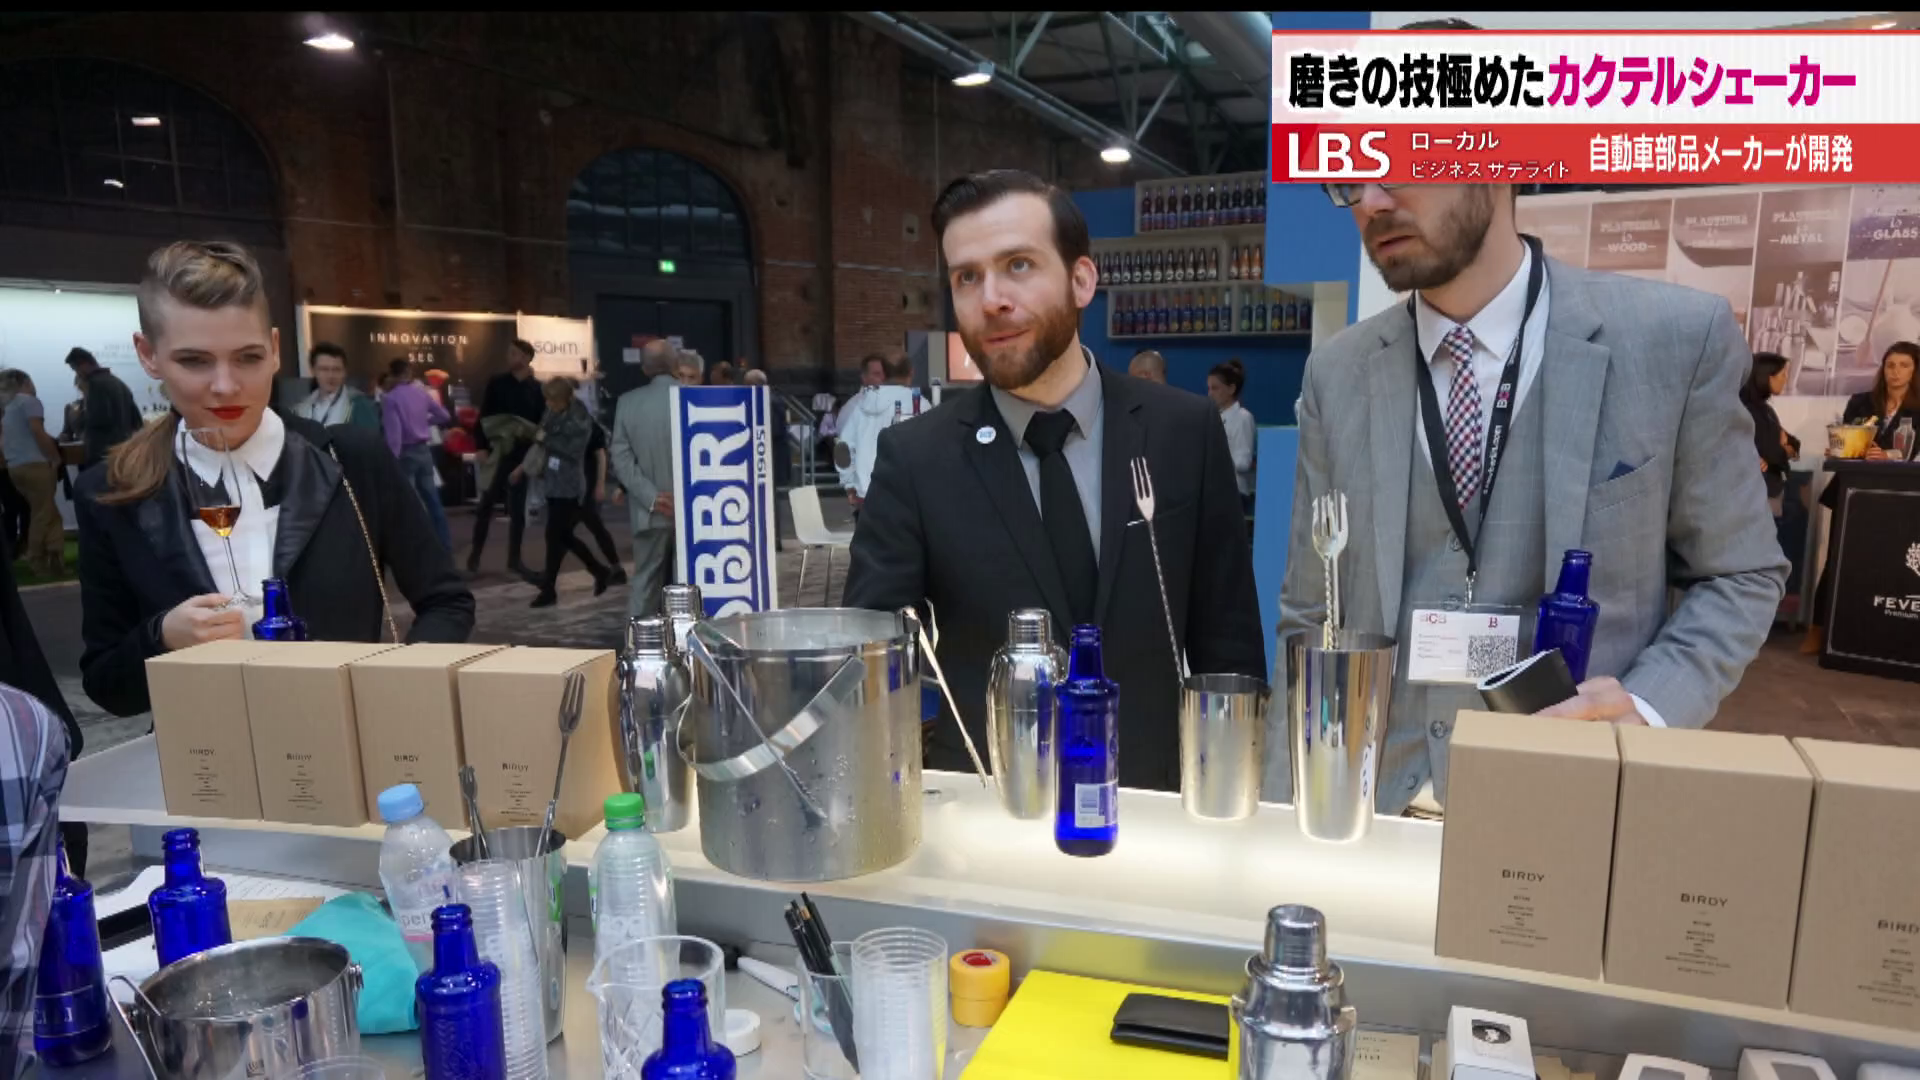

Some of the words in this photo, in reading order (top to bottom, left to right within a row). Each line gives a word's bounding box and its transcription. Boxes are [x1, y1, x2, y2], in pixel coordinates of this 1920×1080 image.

[1607, 241, 1648, 254] WOOD
[1780, 234, 1824, 246] METAL
[369, 331, 469, 346] INNOVATION
[756, 428, 767, 482] 1905
[687, 400, 754, 618] BBRI
[1502, 868, 1545, 882] BIRDY
[1681, 893, 1729, 908] BIRDY
[1877, 919, 1920, 935] BIRD
